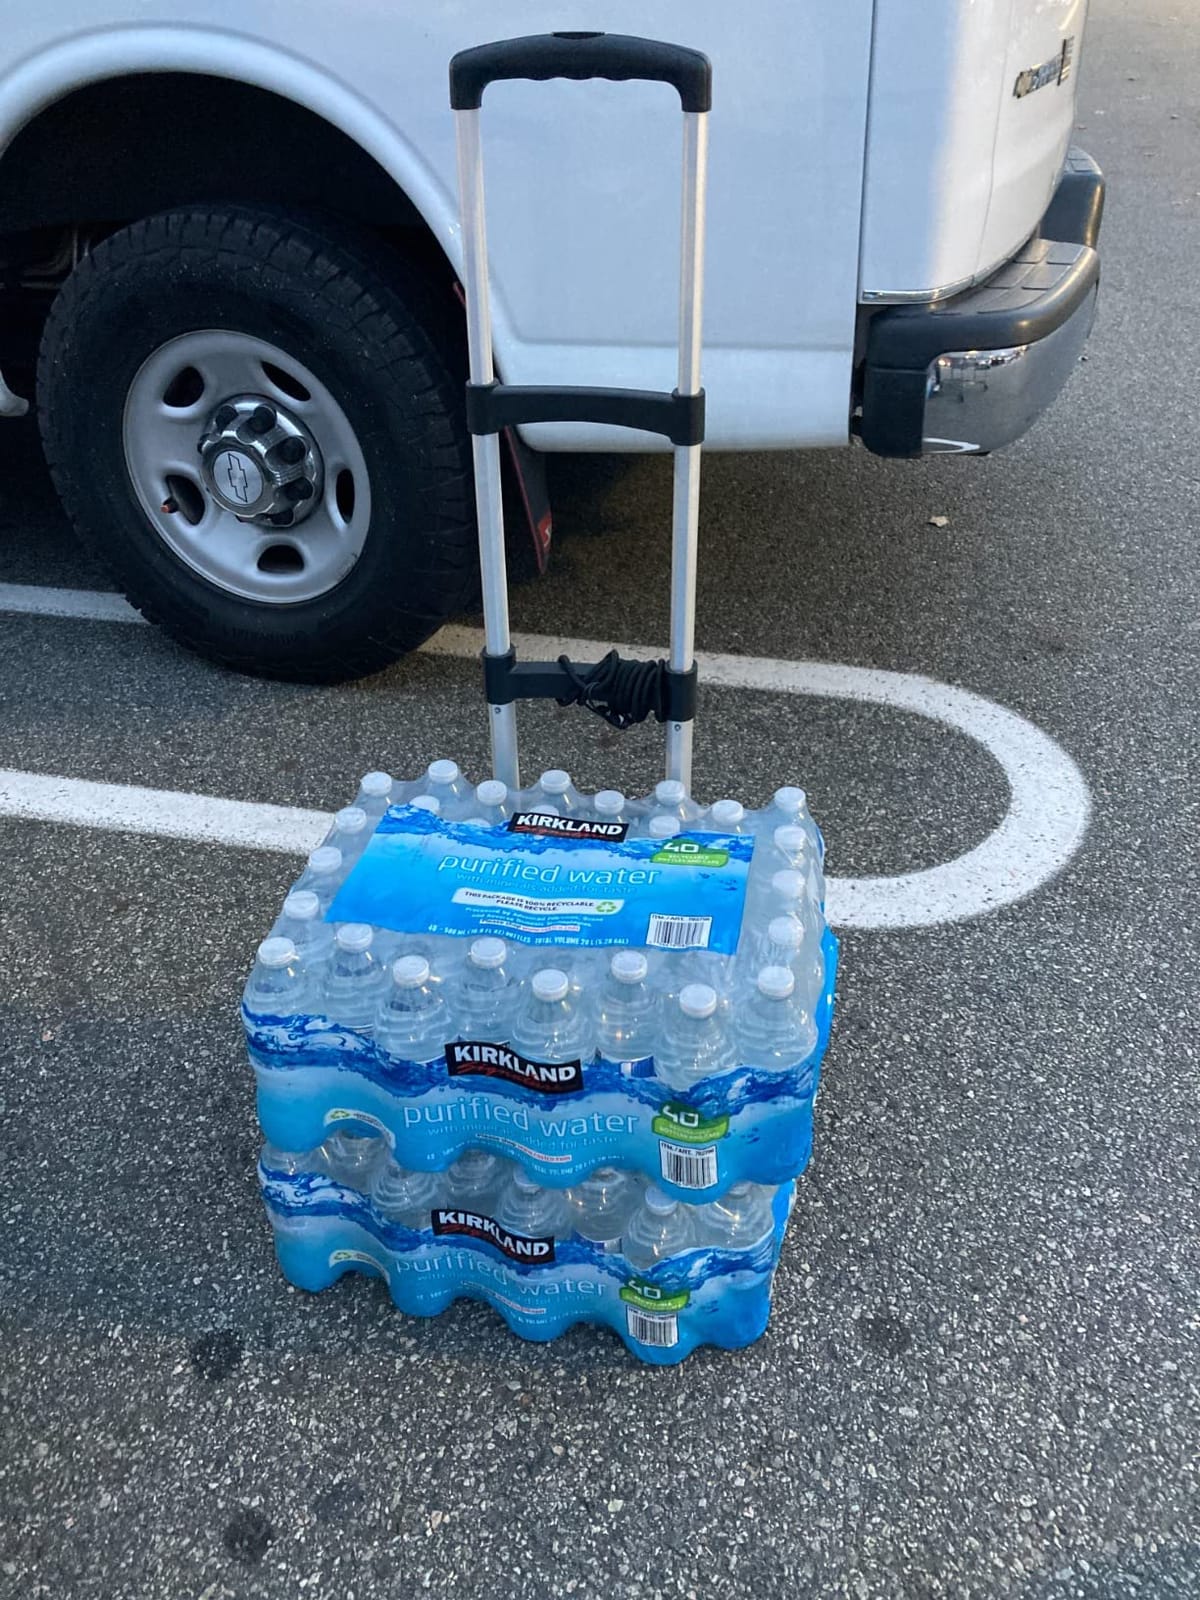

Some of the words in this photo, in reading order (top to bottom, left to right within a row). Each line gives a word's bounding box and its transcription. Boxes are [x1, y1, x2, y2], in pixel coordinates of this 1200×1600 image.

[516, 814, 624, 836] KIRKLAND
[663, 842, 700, 853] 40
[438, 855, 560, 883] purified
[569, 868, 661, 885] water
[496, 900, 524, 908] PLEASE
[454, 1045, 577, 1083] KIRKLAND
[403, 1097, 529, 1132] purified
[540, 1112, 638, 1138] water
[662, 1105, 699, 1128] 40
[439, 1211, 550, 1257] KIRKLAND
[396, 1251, 508, 1285] purified
[520, 1279, 607, 1297] water
[628, 1279, 661, 1299] 40
